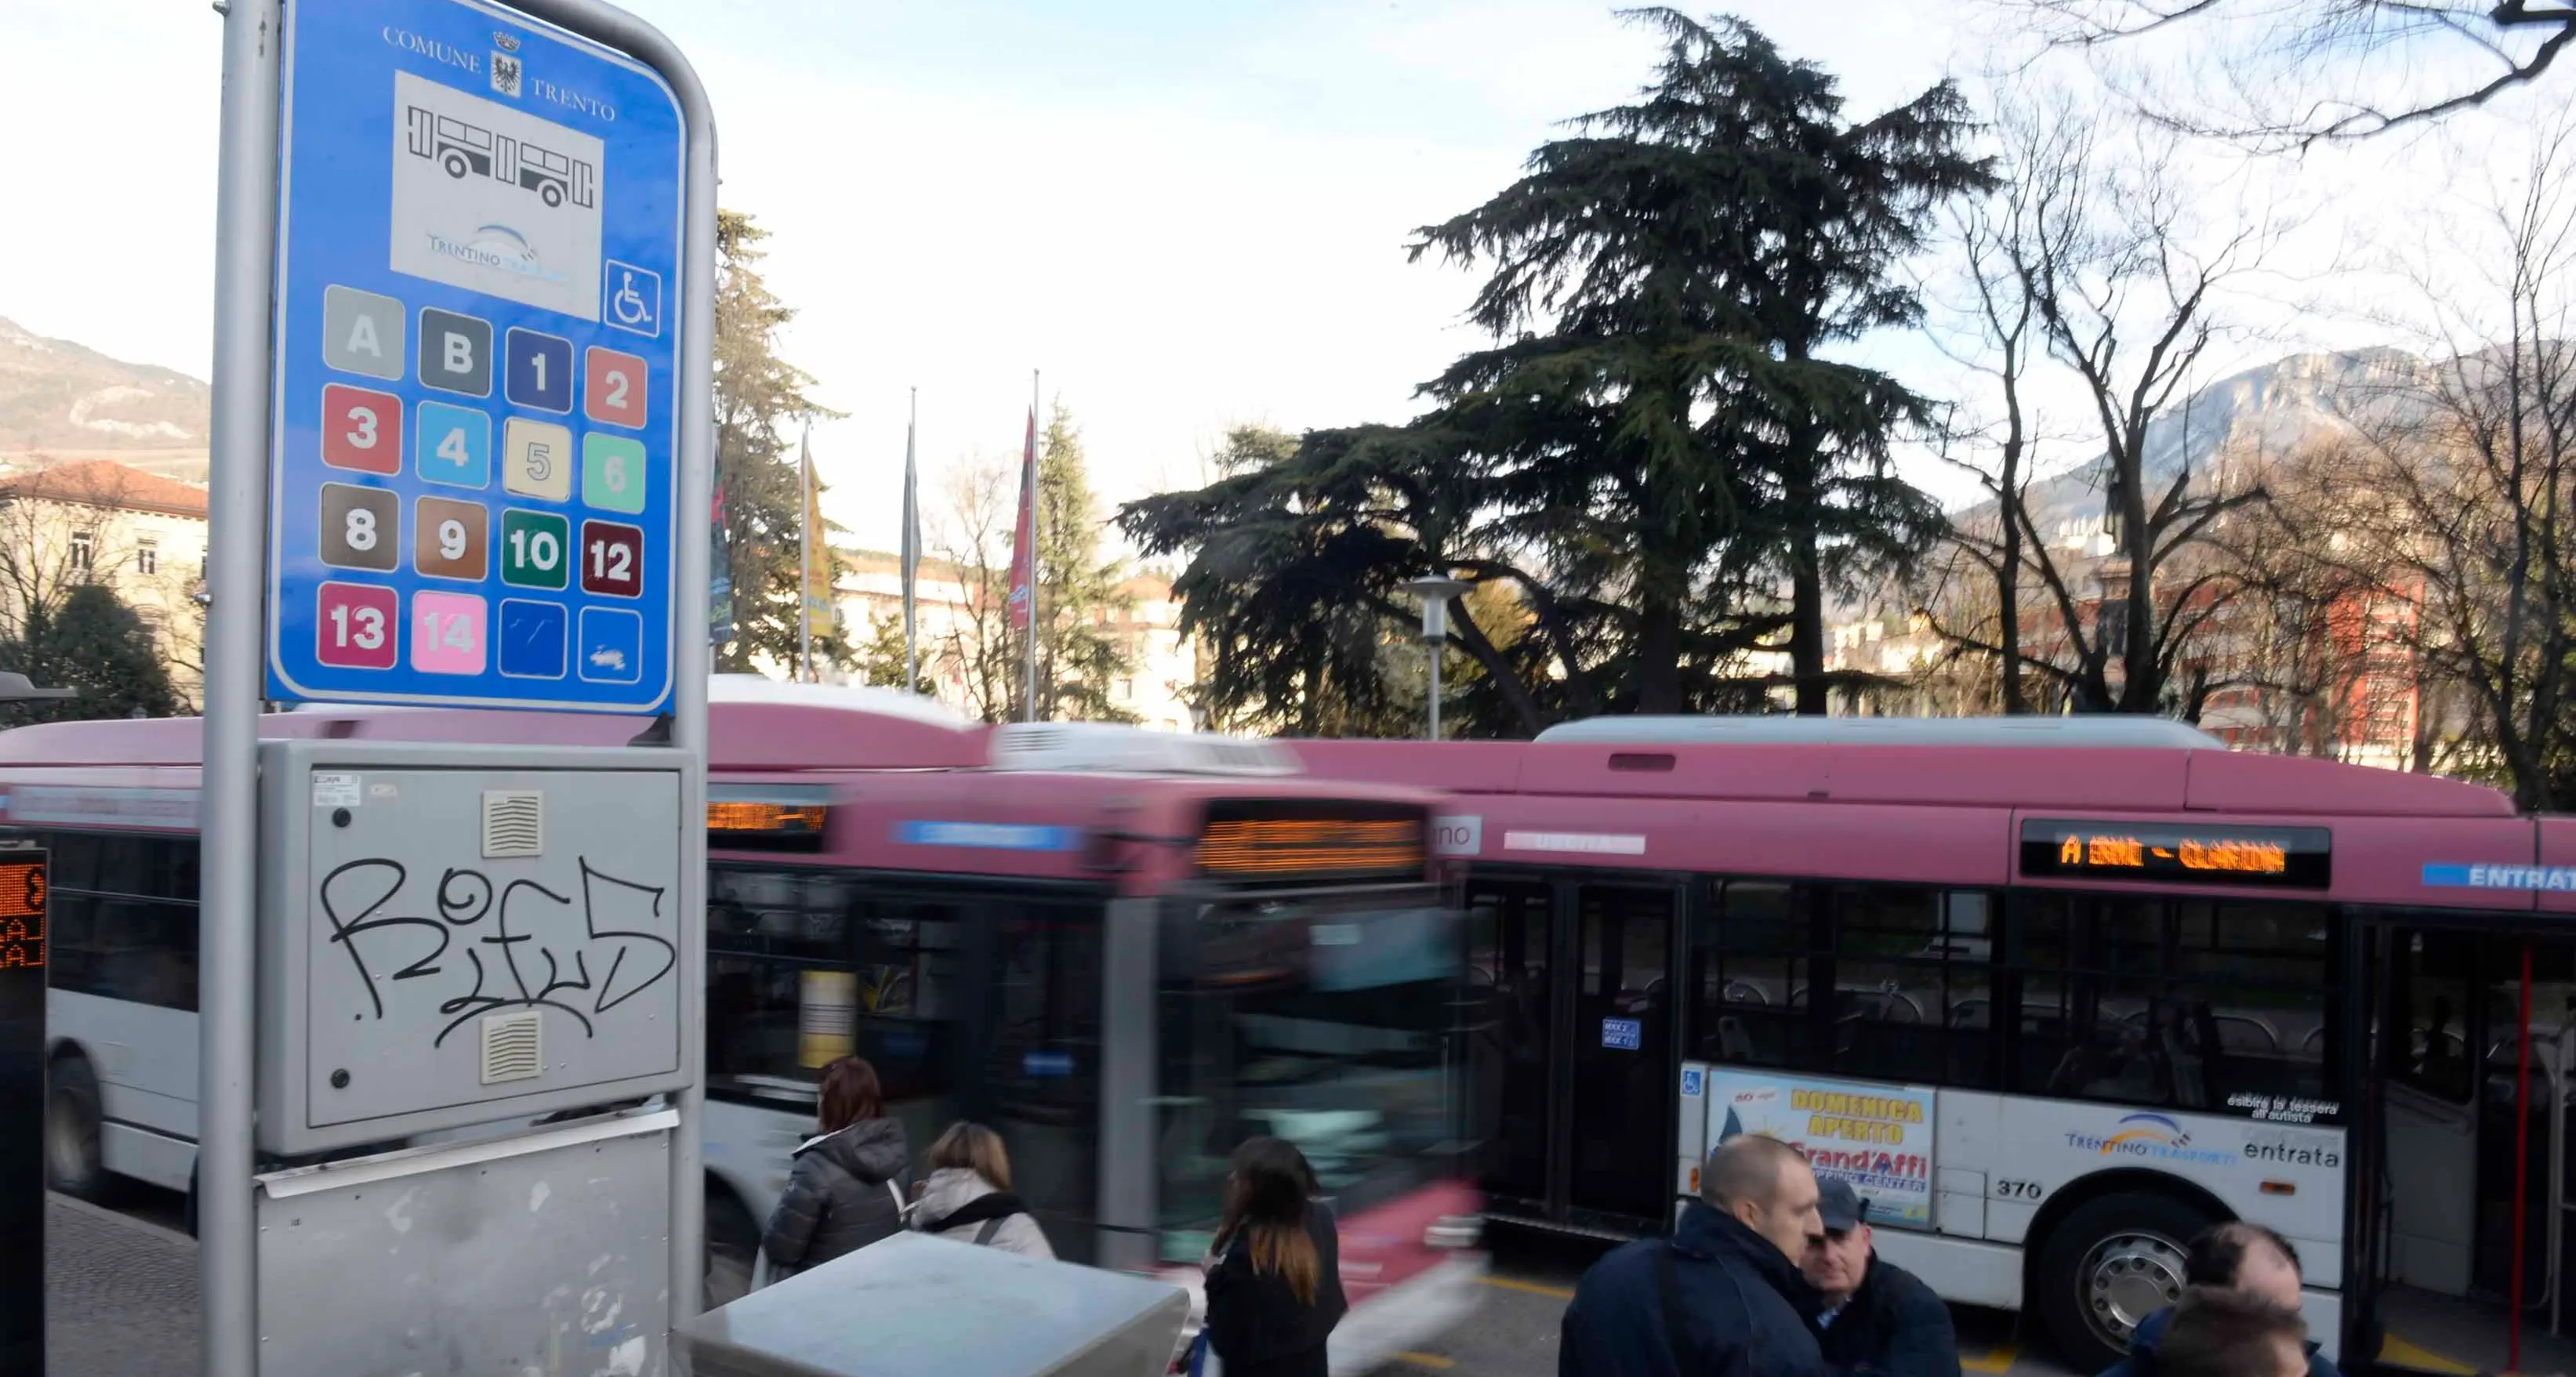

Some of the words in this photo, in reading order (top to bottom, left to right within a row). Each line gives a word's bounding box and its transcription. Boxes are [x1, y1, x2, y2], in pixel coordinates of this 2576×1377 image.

[383, 26, 481, 74] COMUNE
[531, 77, 615, 121] TRENTO
[346, 315, 381, 357] A
[444, 332, 473, 374] B
[531, 353, 546, 391] 1
[605, 371, 628, 409] 2
[346, 407, 378, 448] 3
[436, 428, 469, 466] 4
[526, 442, 551, 480] 5
[604, 455, 626, 493] 6
[346, 508, 377, 550] 8
[439, 519, 466, 560] 9
[510, 529, 559, 571] 10
[590, 541, 632, 581] 12
[330, 605, 385, 650] 13
[423, 613, 475, 654] 14
[1791, 1088, 1923, 1123] DOMENICA
[1808, 1114, 1903, 1145] APERTO
[2065, 1133, 2147, 1156] TRENTINO
[2244, 1142, 2340, 1168] entrata
[1863, 1174, 1925, 1193] CENTER
[1997, 1180, 2042, 1200] 370
